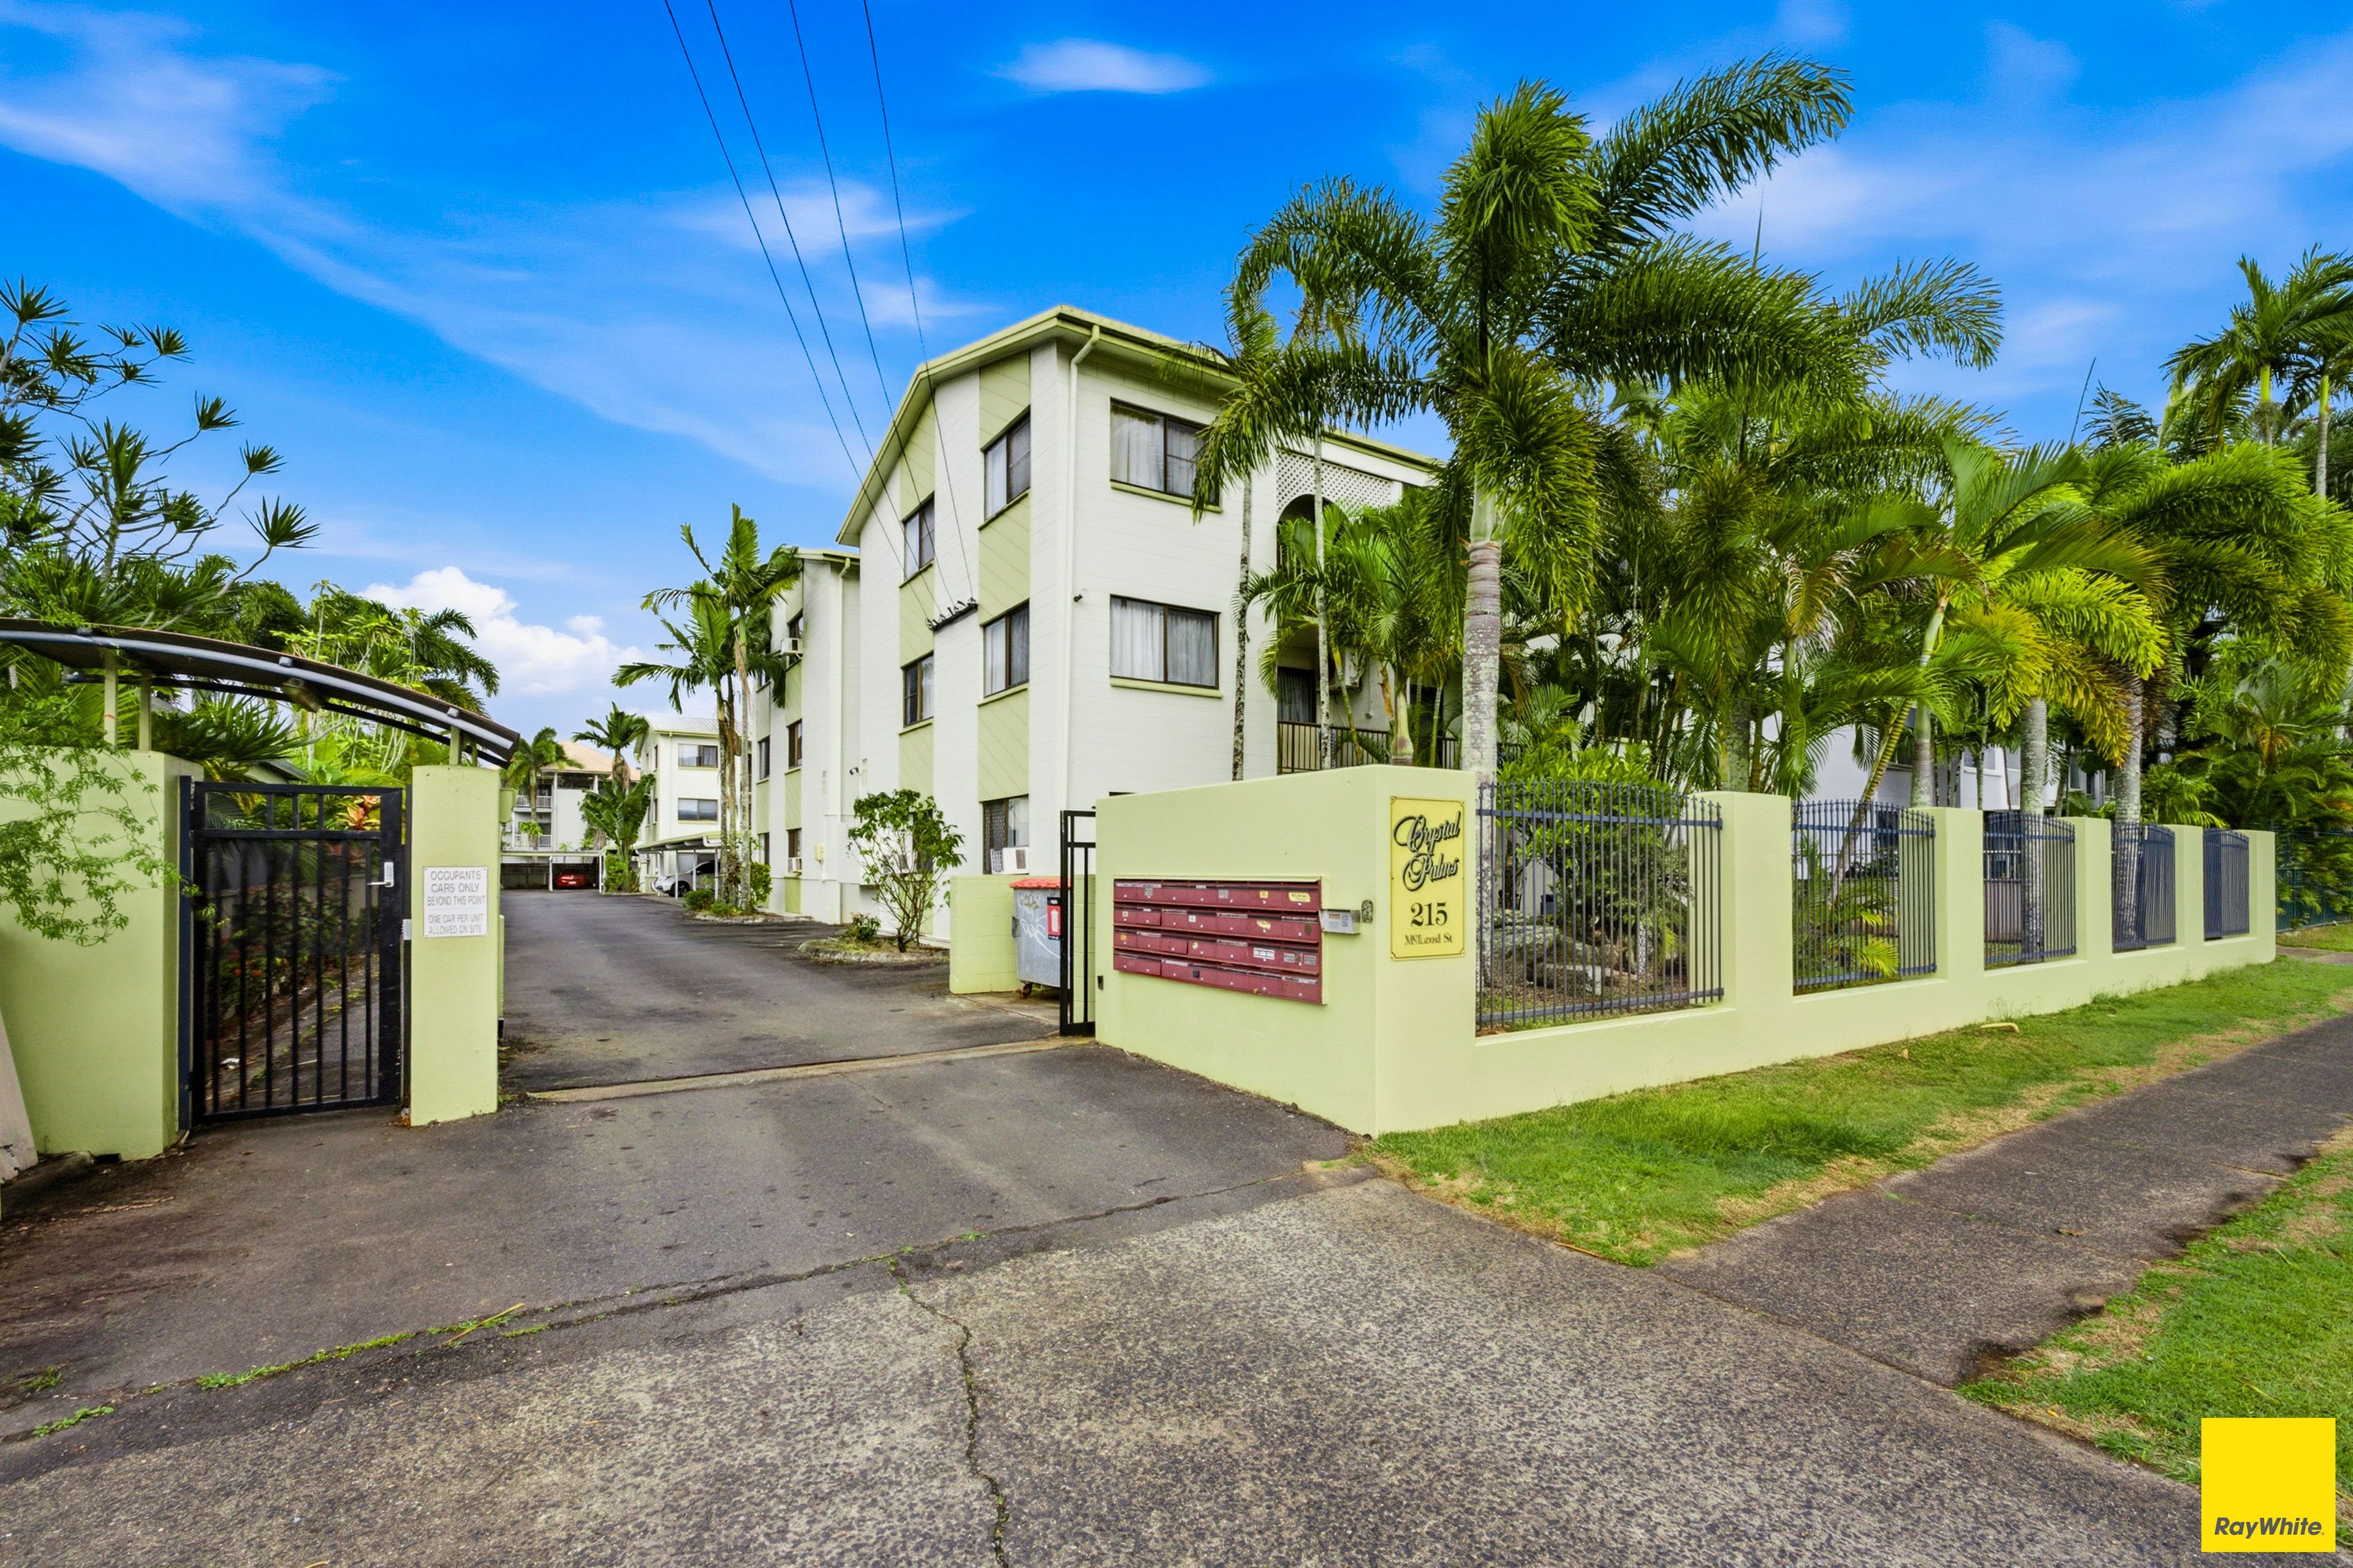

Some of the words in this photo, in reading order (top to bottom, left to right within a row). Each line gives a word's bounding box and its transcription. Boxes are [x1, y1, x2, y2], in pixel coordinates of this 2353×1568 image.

[1393, 811, 1461, 853] Crystal
[431, 871, 481, 880] OCCUPANTS
[1403, 852, 1460, 892] Palms
[431, 884, 455, 893] CARS
[458, 883, 479, 892] ONLY
[427, 896, 452, 906] BEYOND
[453, 896, 466, 905] THIS
[468, 895, 485, 904] POINT
[429, 915, 441, 923] ONE
[1411, 902, 1448, 926] 215
[470, 925, 482, 933] SITE
[1443, 933, 1453, 944] St
